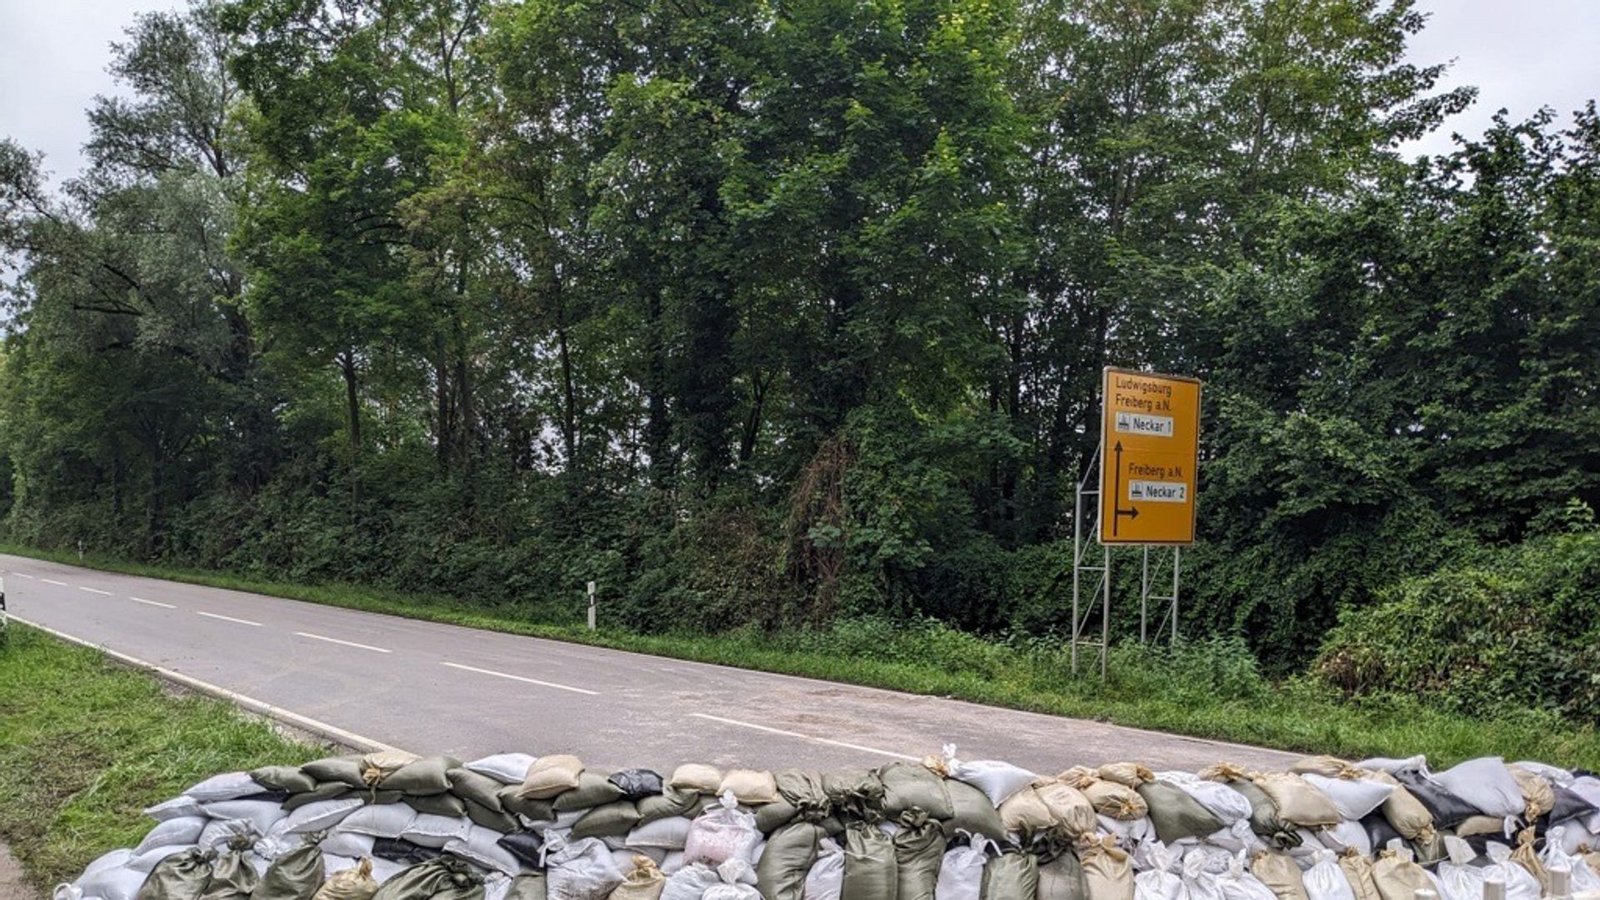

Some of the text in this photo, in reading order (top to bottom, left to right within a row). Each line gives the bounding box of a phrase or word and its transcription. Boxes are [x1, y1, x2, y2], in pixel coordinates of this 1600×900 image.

[1115, 376, 1172, 397] Ludwigsburg
[1115, 393, 1172, 412] Freiberg a.N.
[1133, 417, 1172, 433] Neckar 1
[1128, 462, 1183, 479] Freiberg a.N.
[1146, 483, 1185, 499] Neckar 2
